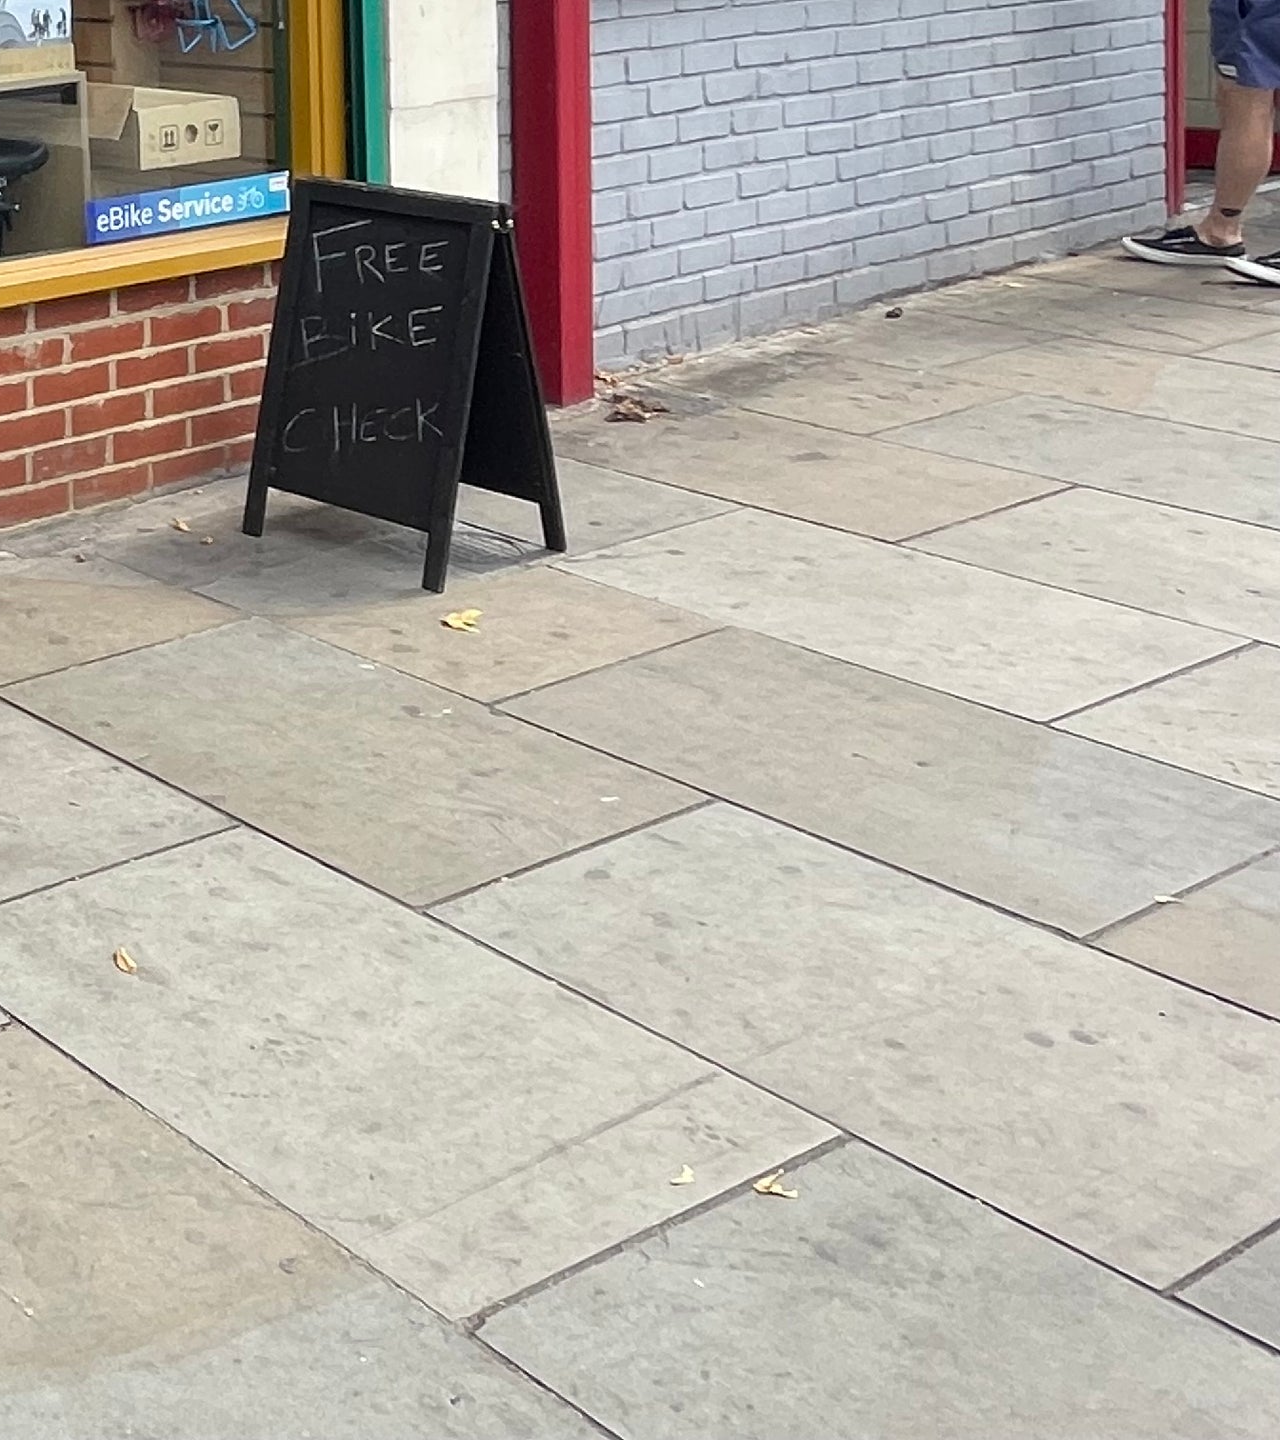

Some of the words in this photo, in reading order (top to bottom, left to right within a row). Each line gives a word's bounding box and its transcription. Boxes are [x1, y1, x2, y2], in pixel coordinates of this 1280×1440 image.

[96, 202, 154, 233] eBike
[157, 191, 234, 222] Service
[312, 219, 449, 293] FREE
[282, 398, 444, 453] CHECK
